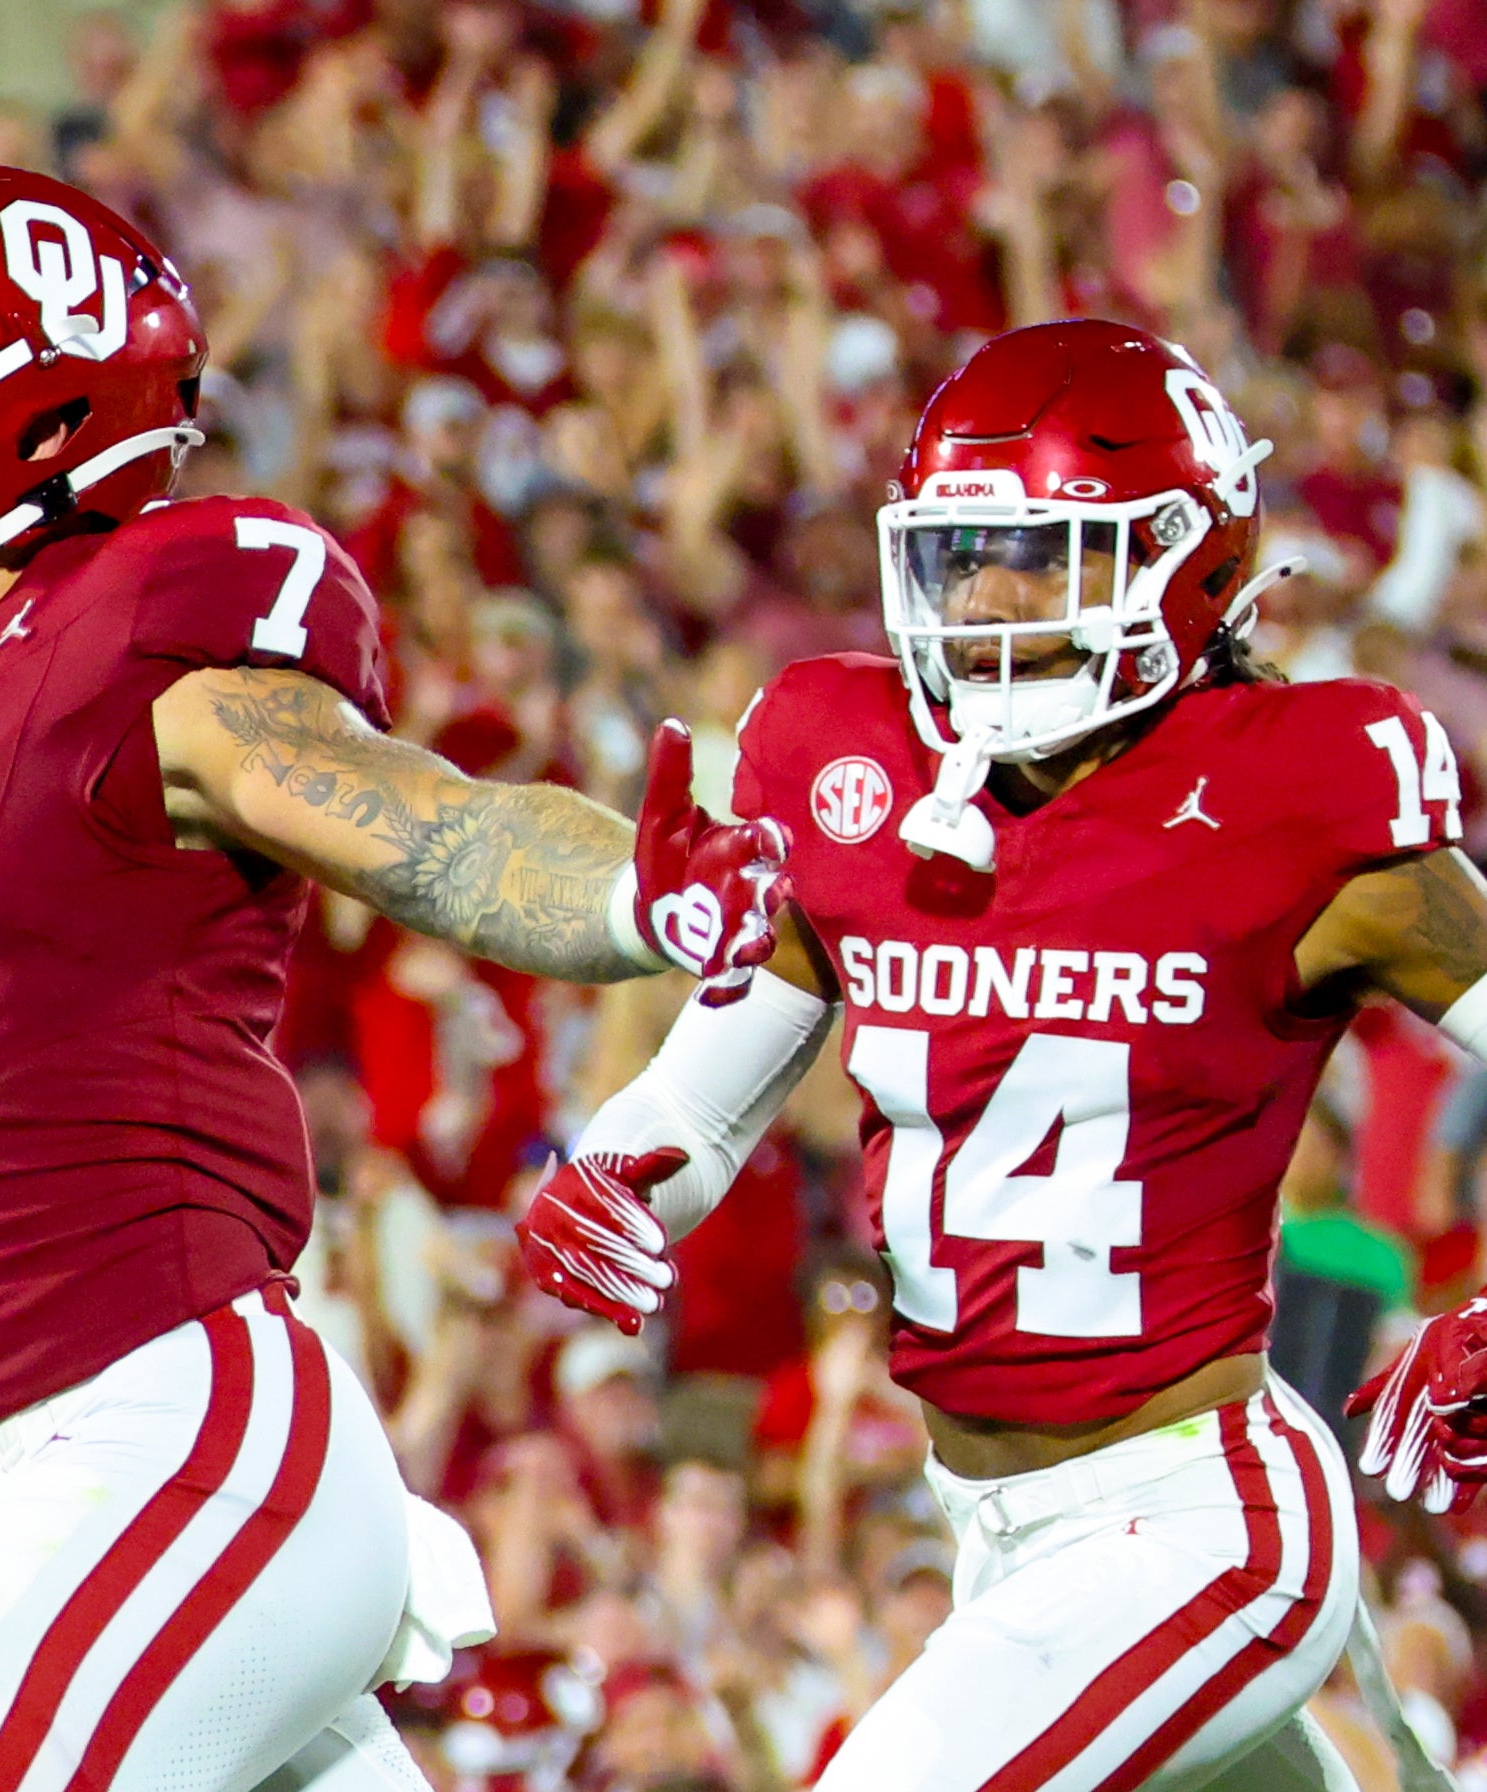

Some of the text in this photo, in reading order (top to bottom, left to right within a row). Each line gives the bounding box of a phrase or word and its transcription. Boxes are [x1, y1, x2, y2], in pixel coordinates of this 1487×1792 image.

[0, 199, 127, 362] OU
[234, 516, 327, 660] 7
[816, 763, 886, 838] SEC
[1365, 710, 1464, 848] 14
[839, 935, 1208, 1025] SOONERS
[846, 1024, 1144, 1338] 14
